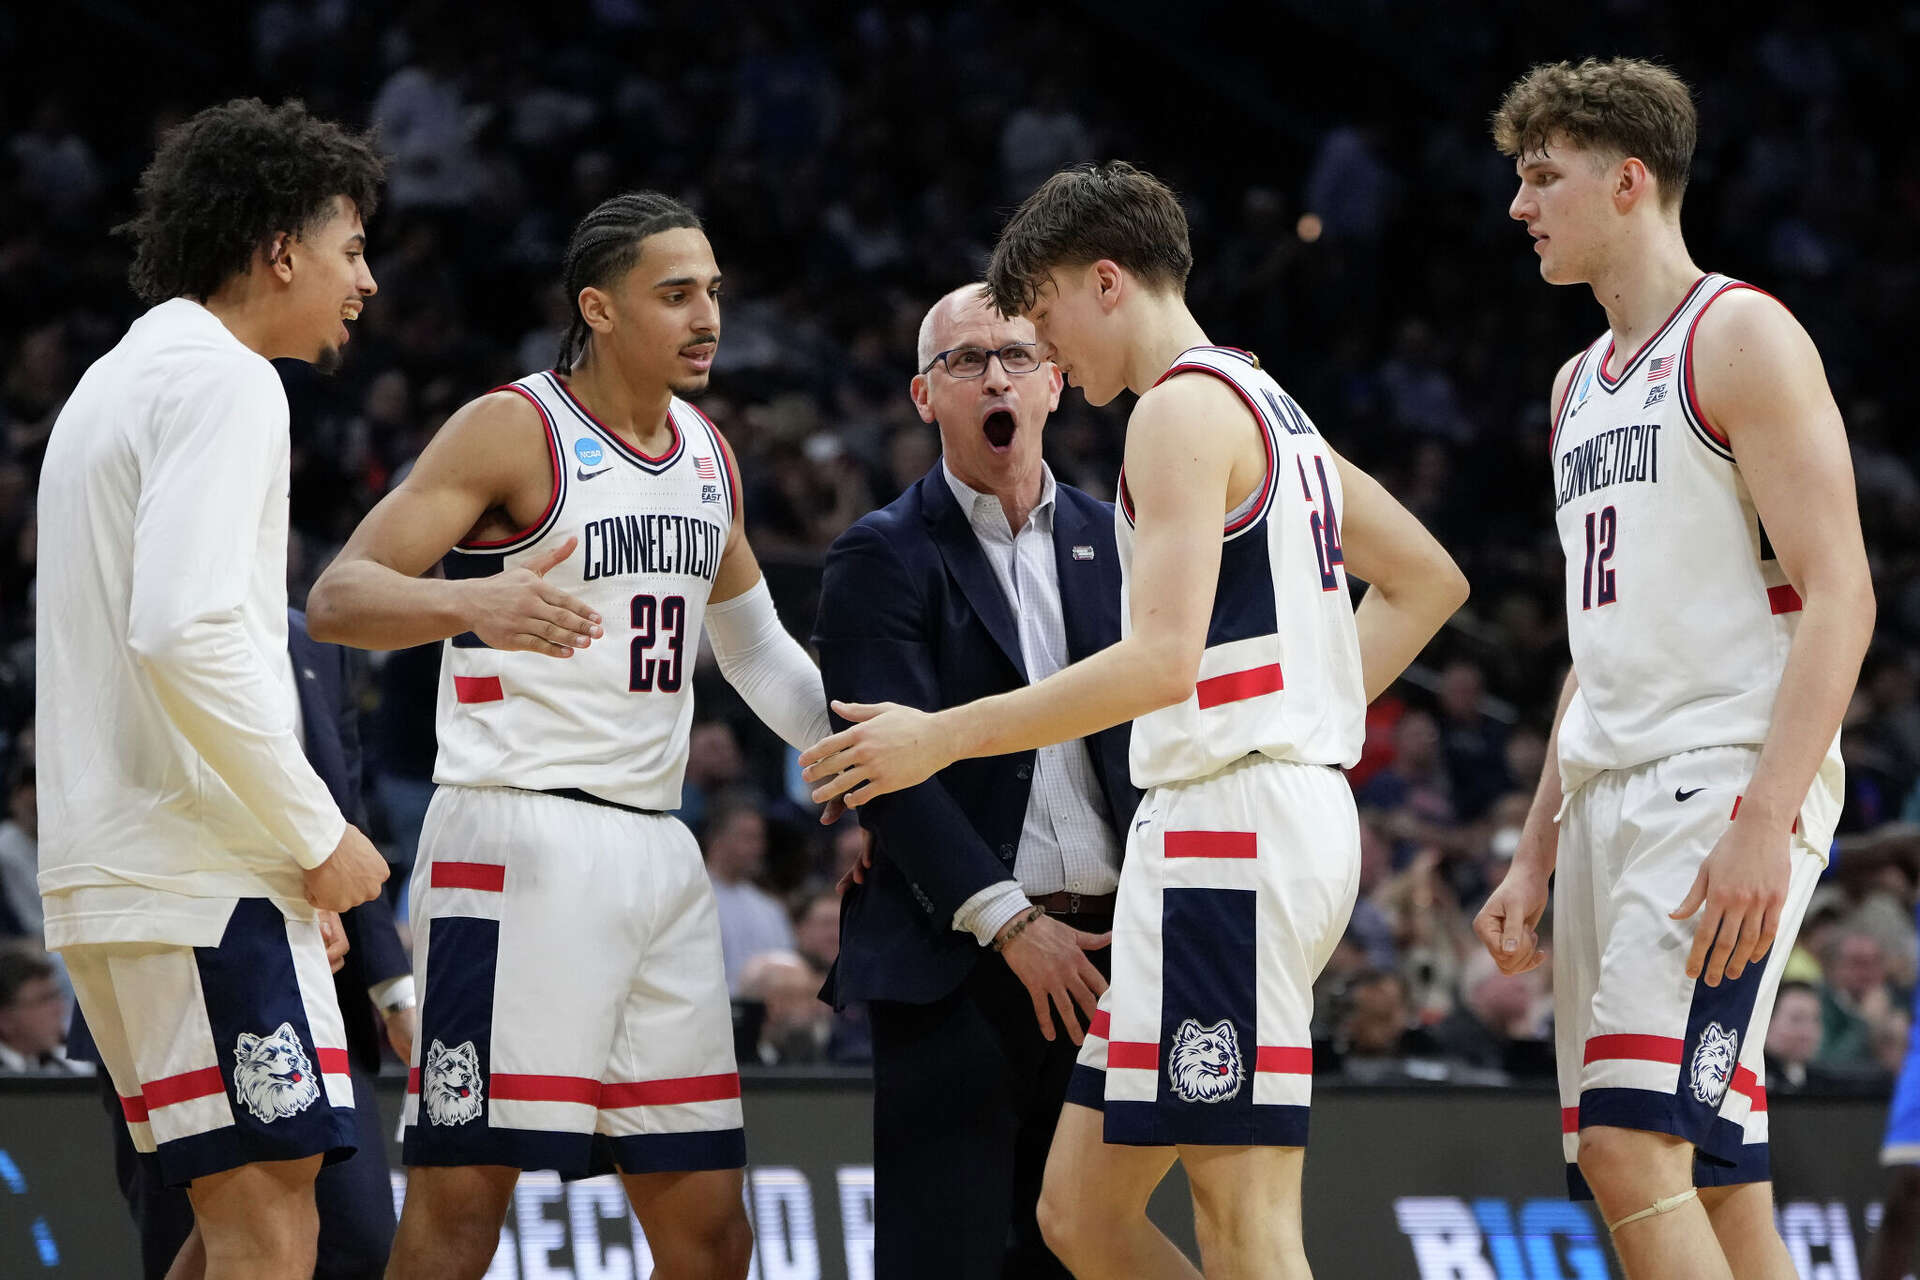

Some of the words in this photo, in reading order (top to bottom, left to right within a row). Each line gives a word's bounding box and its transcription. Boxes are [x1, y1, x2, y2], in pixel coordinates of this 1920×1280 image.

[1645, 391, 1668, 404] EAST
[701, 493, 721, 501] EAST
[702, 485, 716, 493] BIG
[1556, 424, 1661, 511] CONNECTICUT
[584, 515, 721, 583] CONNECTICUT
[1583, 505, 1618, 611] 12
[629, 594, 686, 692] 23
